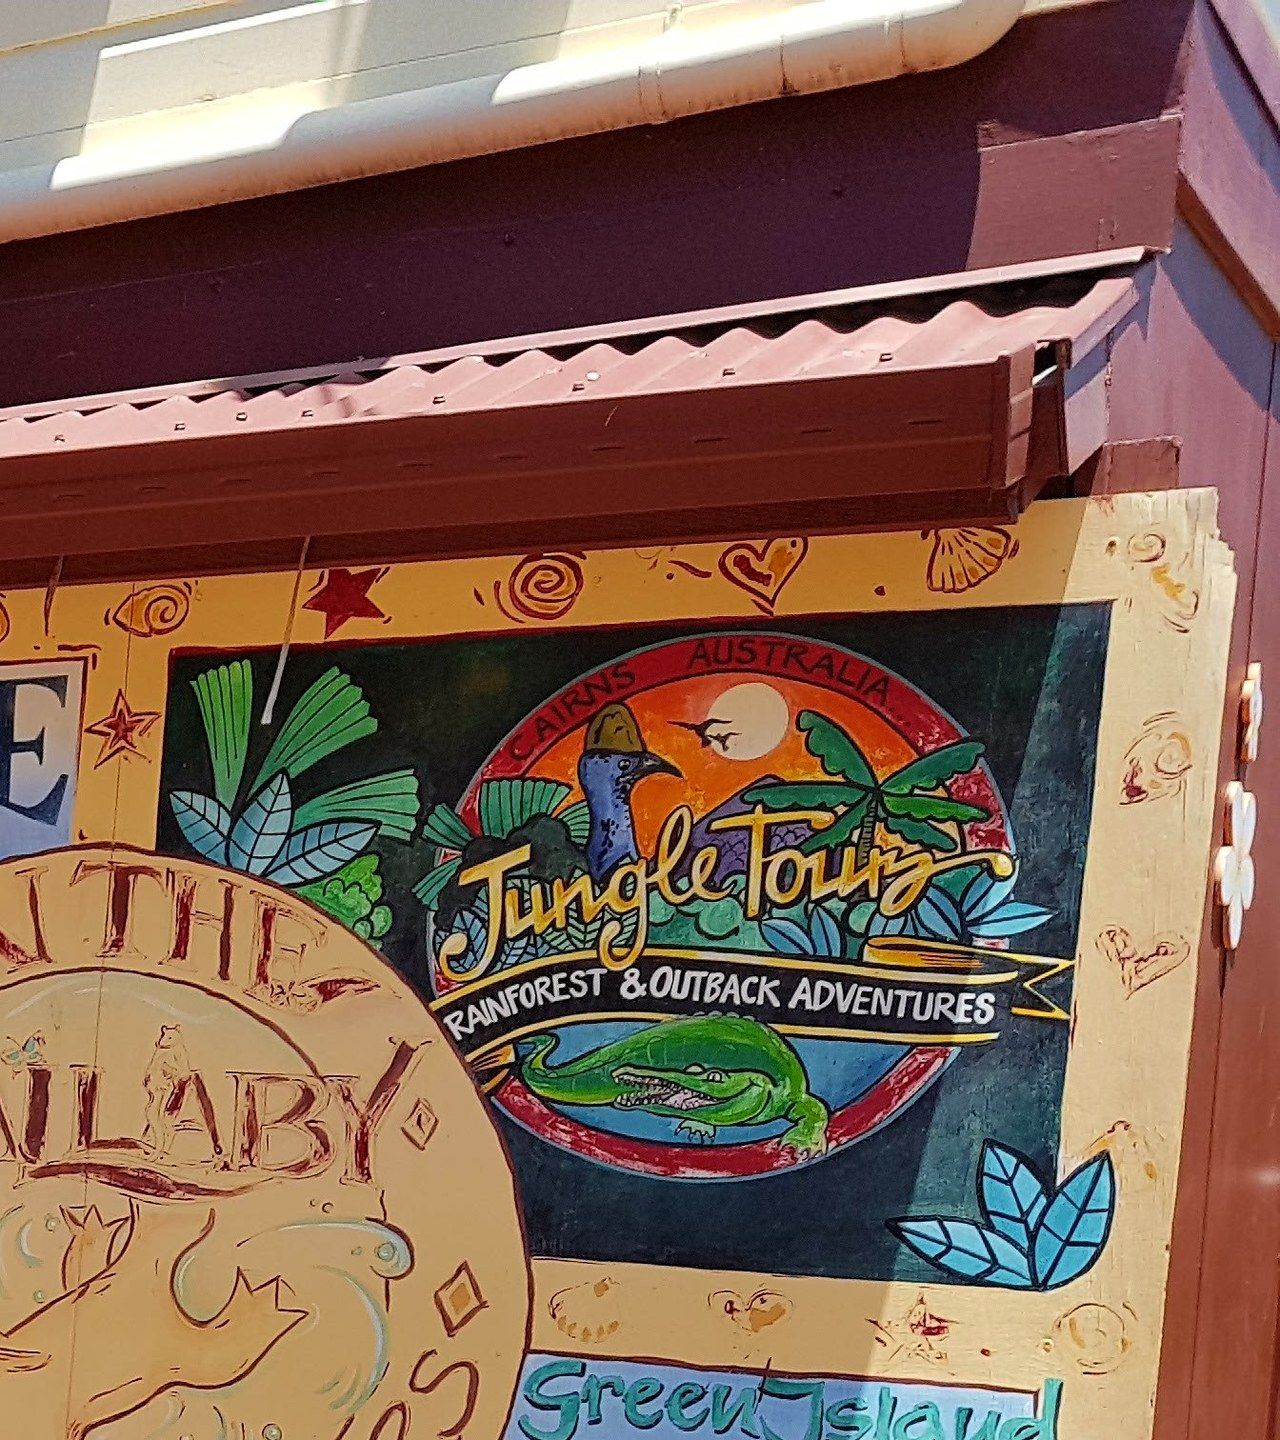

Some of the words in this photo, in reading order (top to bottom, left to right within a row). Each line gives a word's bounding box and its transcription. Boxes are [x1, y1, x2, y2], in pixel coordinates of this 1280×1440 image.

[508, 661, 637, 762] CAIRNS
[687, 638, 891, 698] AUSTRALIA
[69, 860, 382, 1014] THE
[438, 804, 734, 981] Jungle
[443, 967, 608, 1042] RAINFOREST
[650, 964, 781, 1011] OUTBACK
[792, 977, 998, 1028] ADVENTURES
